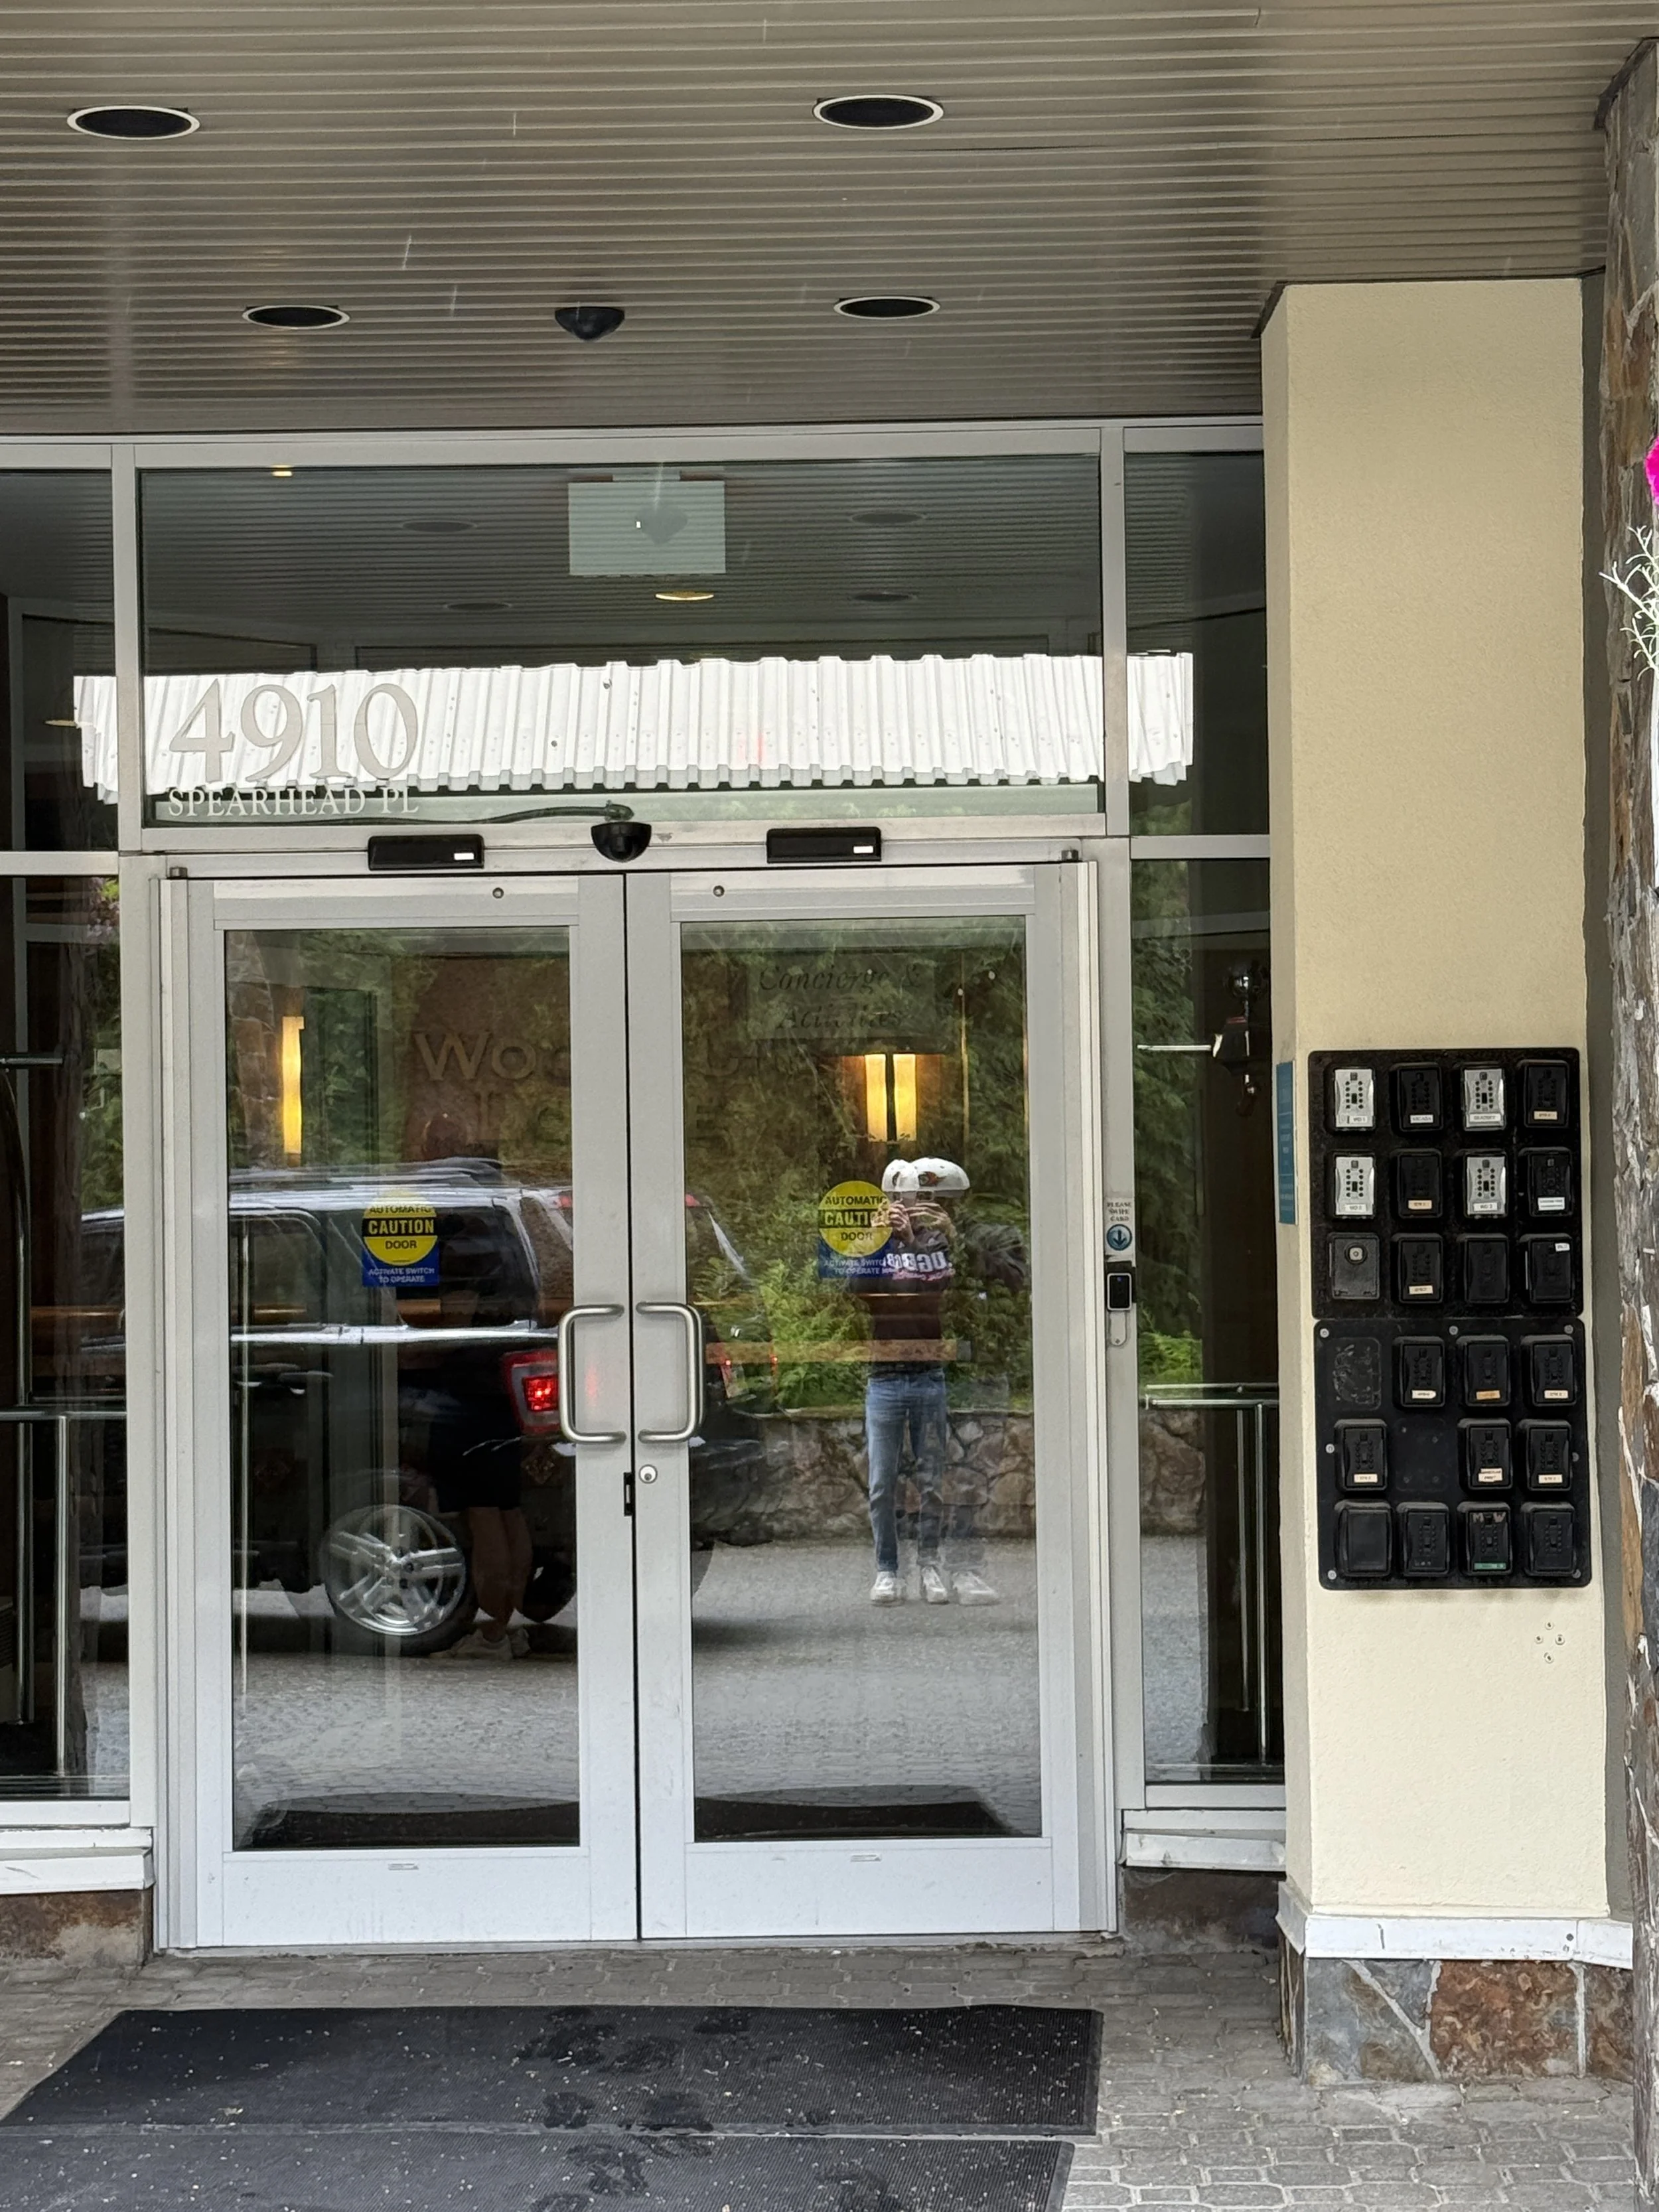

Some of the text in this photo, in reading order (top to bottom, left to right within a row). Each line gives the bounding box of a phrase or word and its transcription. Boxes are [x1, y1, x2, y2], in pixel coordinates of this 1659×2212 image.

[169, 678, 419, 782] 4910
[167, 786, 419, 817] SPEARHEAD PL
[759, 964, 890, 994] Concierge
[825, 1195, 888, 1205] AUTOMATIC
[824, 1211, 883, 1226] CAUTI
[368, 1219, 434, 1234] CAUTION
[841, 1231, 873, 1241] DOOR
[384, 1240, 417, 1250] DOOR
